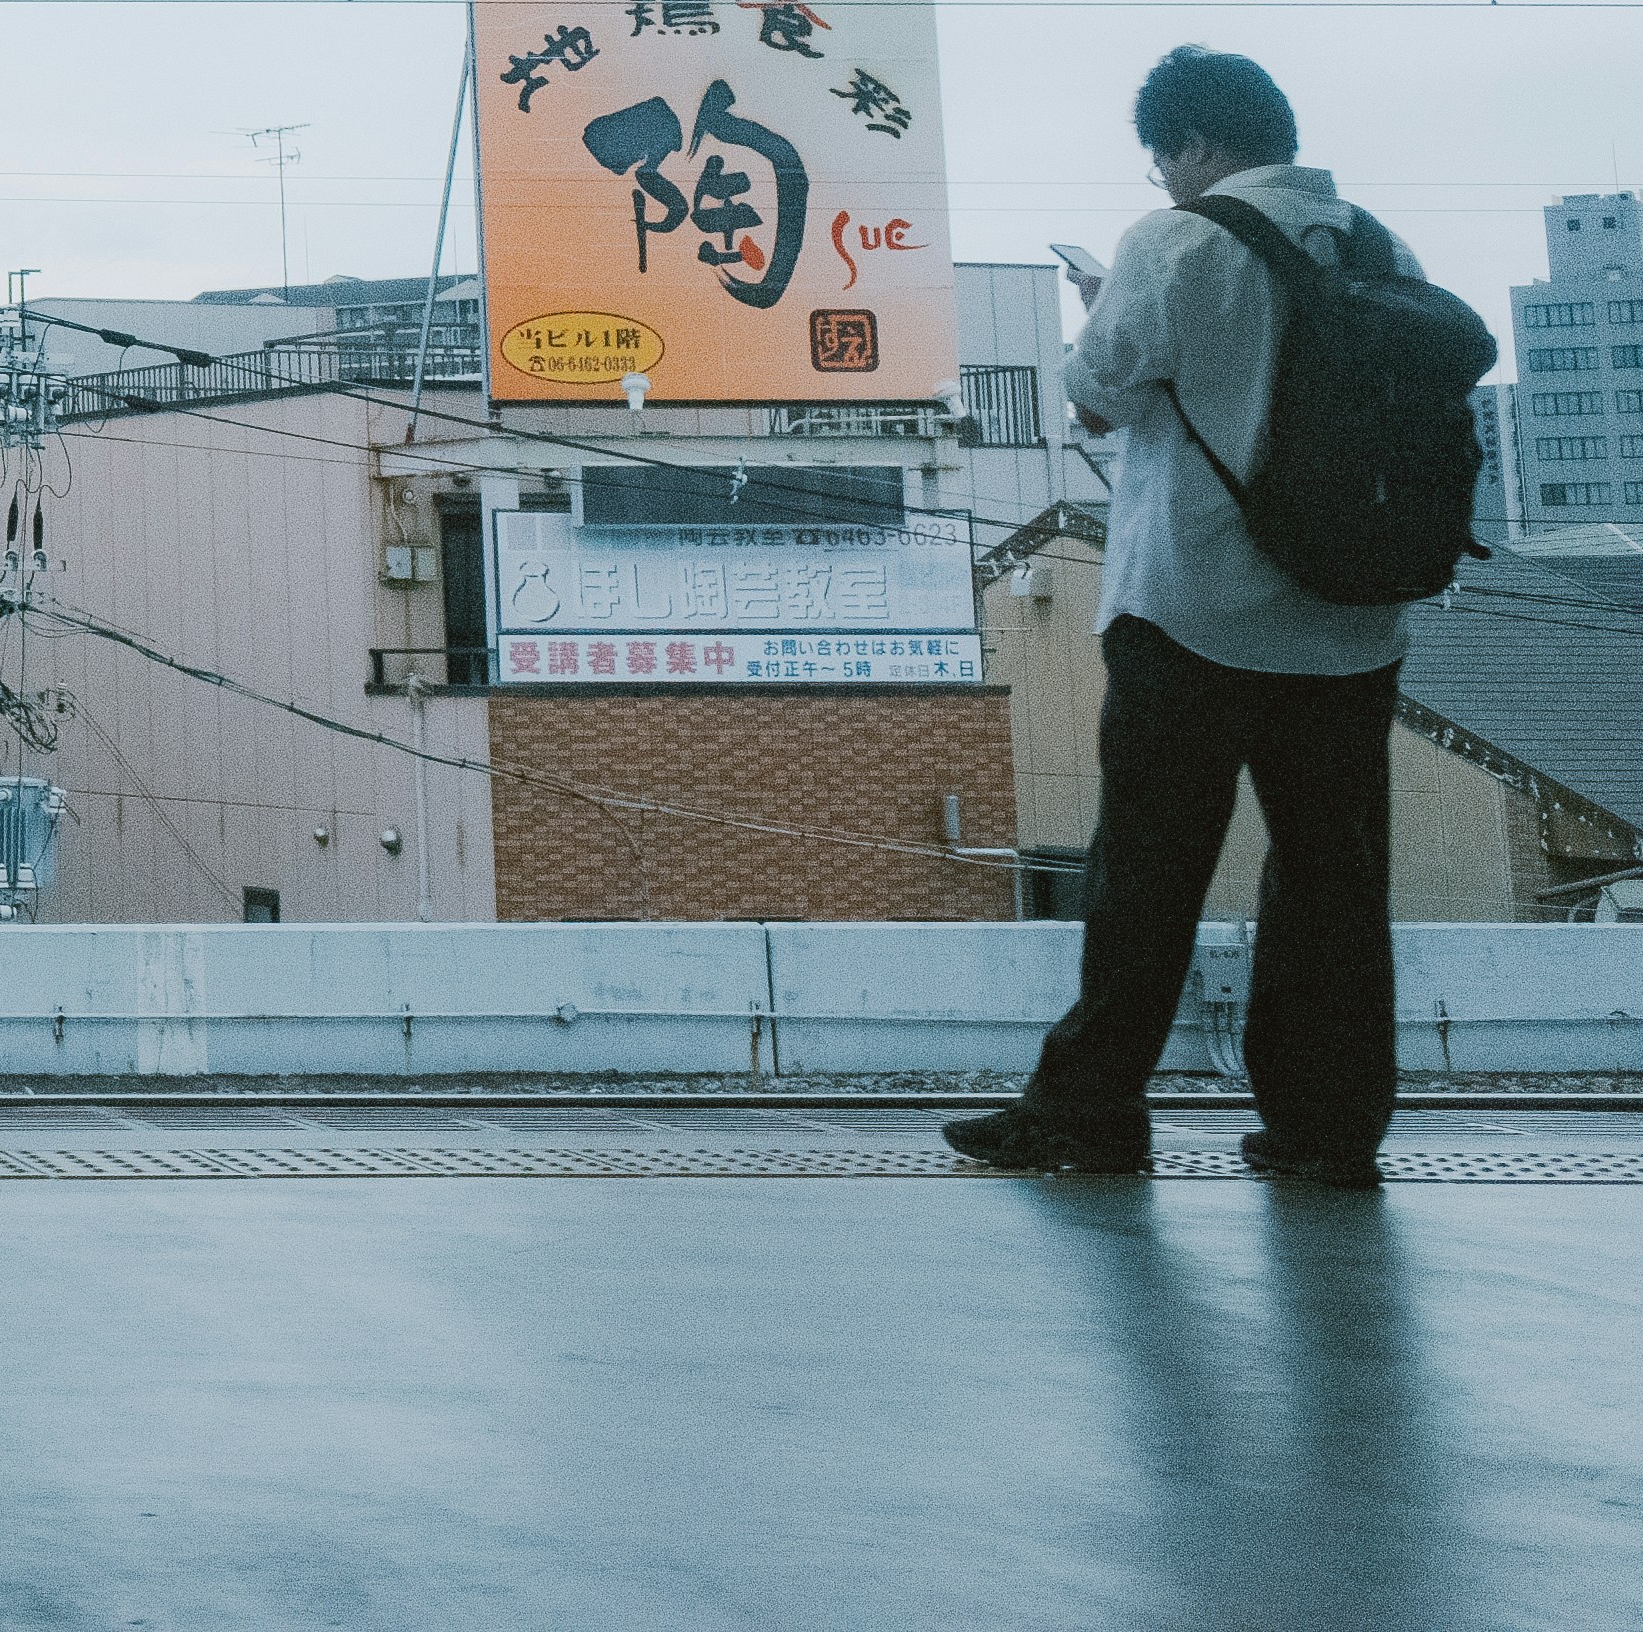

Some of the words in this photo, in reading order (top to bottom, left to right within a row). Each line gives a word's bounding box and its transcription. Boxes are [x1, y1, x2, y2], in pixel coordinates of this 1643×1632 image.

[510, 641, 735, 675] 受講者募集中
[763, 640, 959, 656] お問い合わせはお気軽に
